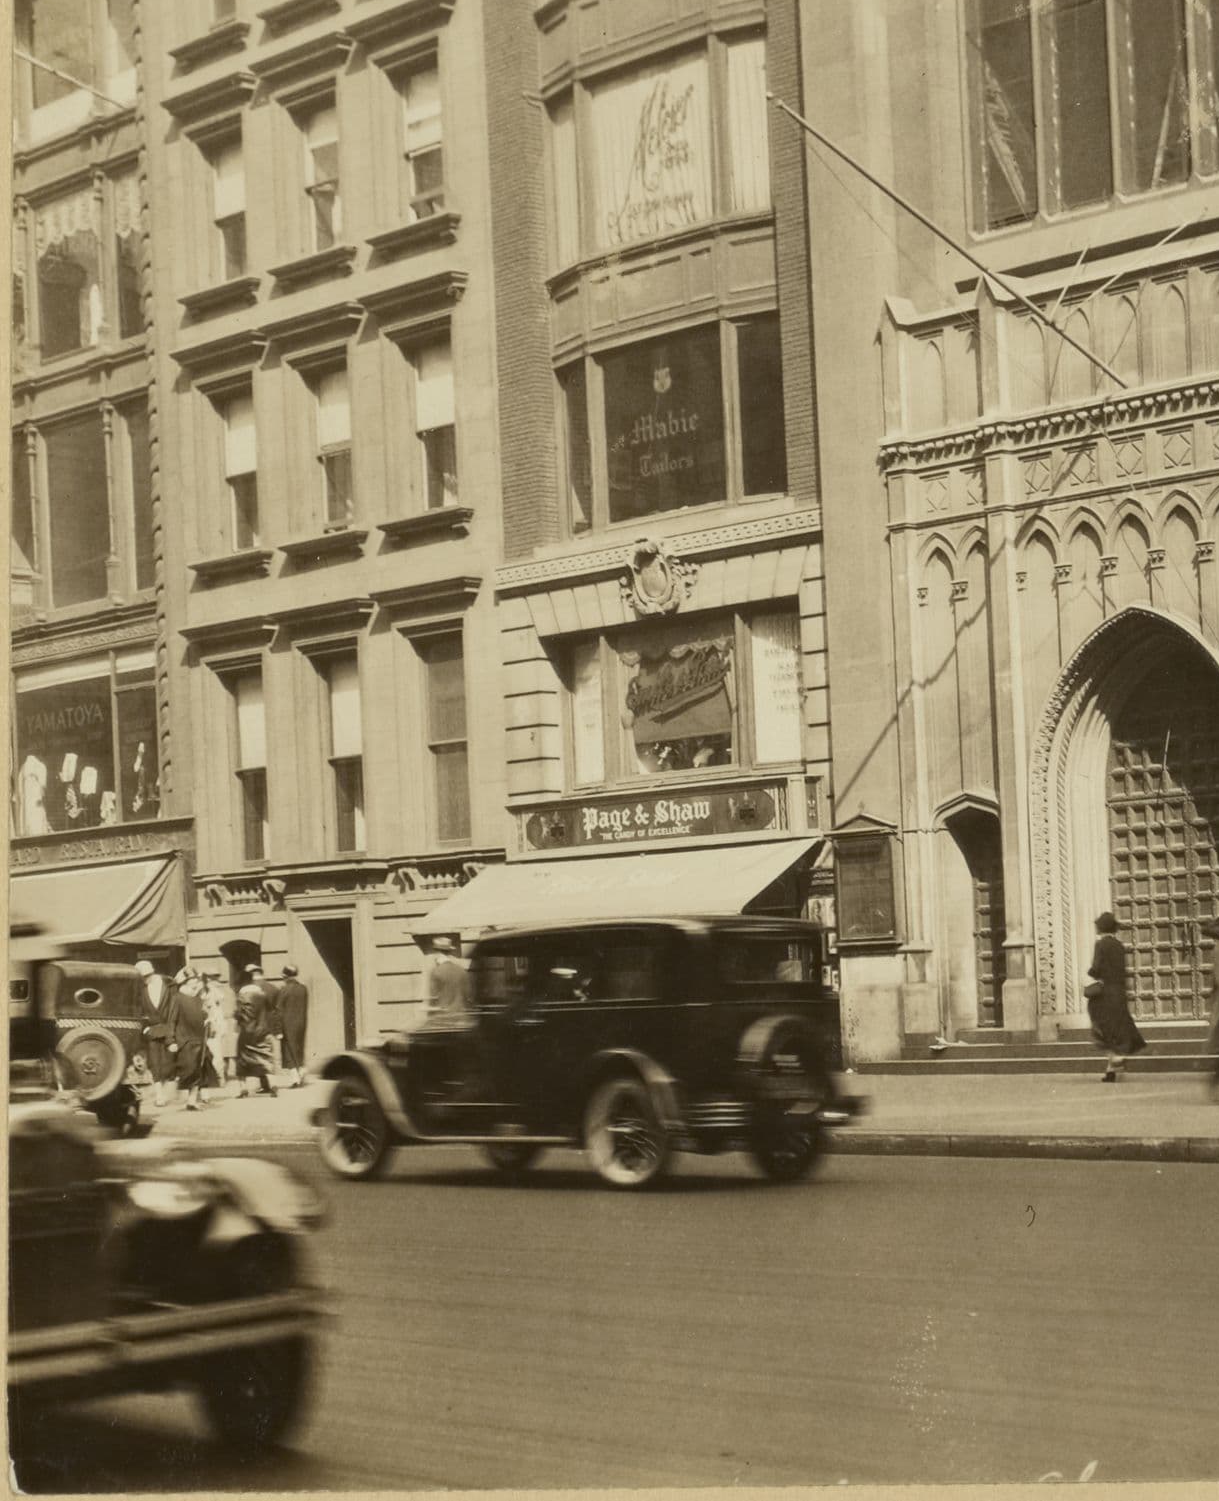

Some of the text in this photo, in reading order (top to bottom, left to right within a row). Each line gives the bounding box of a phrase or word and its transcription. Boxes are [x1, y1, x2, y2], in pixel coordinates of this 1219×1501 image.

[25, 702, 105, 733] YAMATOYA
[582, 799, 711, 840] Page & Shaw
